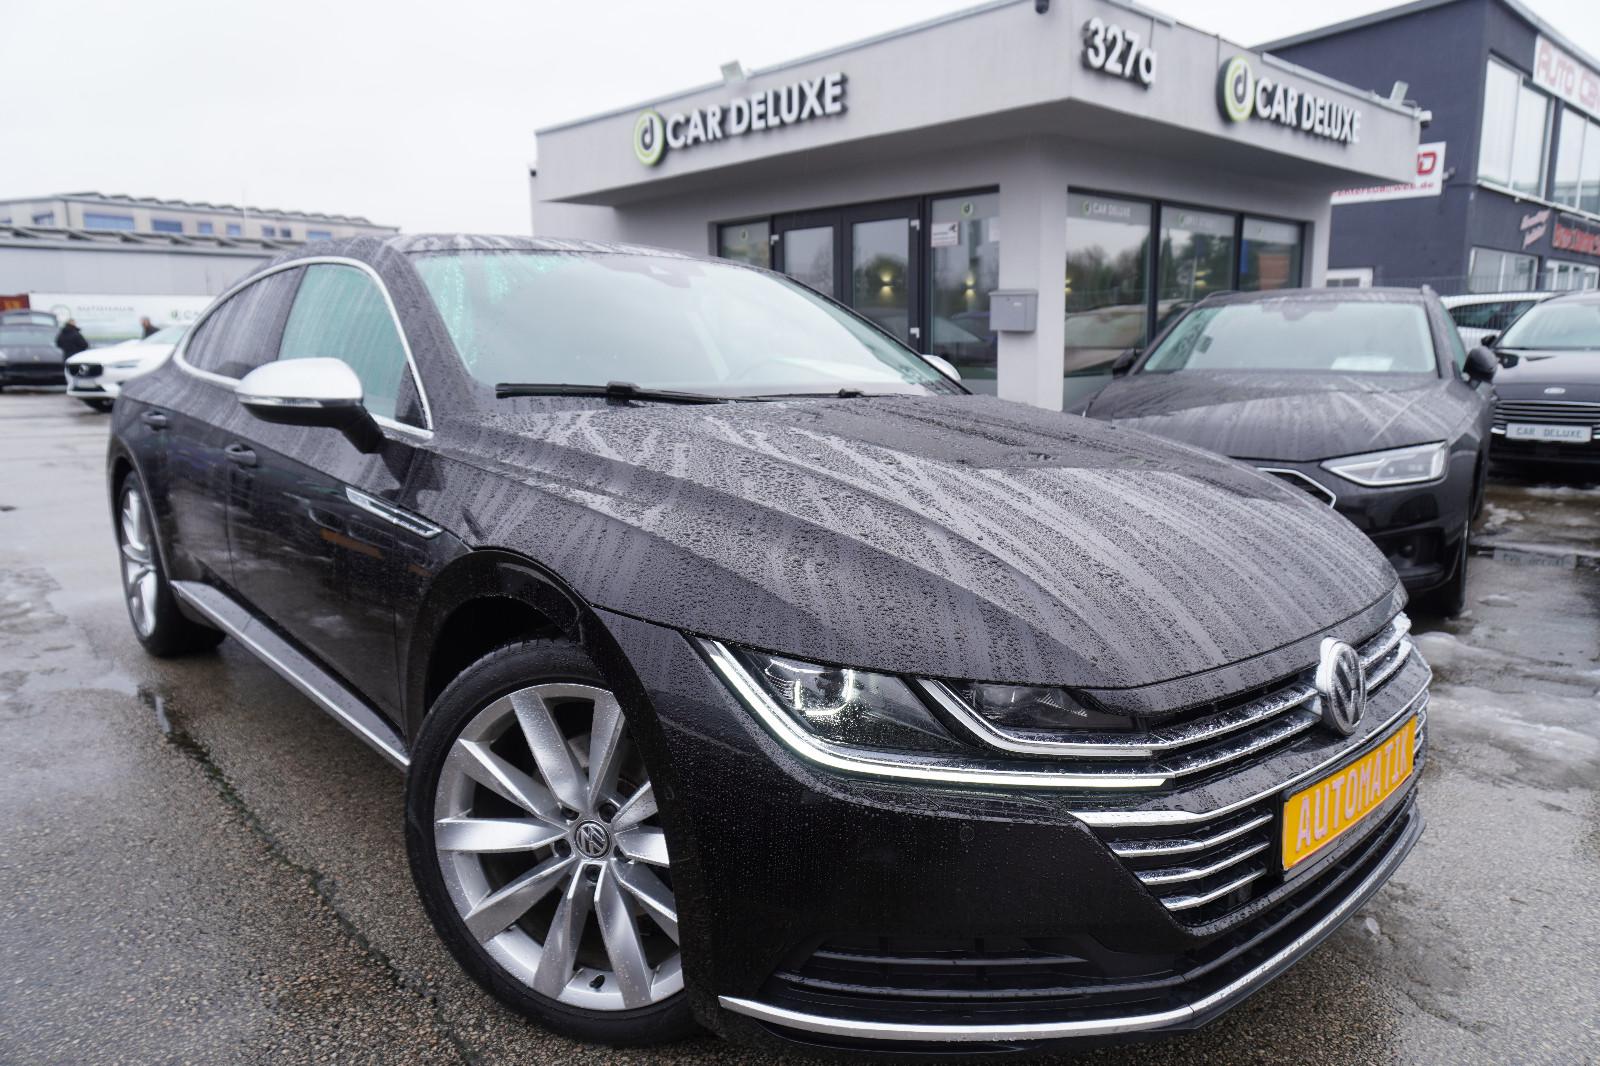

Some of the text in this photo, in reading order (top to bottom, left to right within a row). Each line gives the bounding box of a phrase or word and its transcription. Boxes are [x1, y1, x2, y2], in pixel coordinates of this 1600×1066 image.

[1086, 17, 1157, 84] 327a
[1537, 40, 1574, 96] AUTO
[666, 104, 723, 148] CAR
[730, 72, 843, 136] DELUXE
[1255, 78, 1298, 128] CAR
[1301, 94, 1361, 143] DELUXE
[1295, 726, 1409, 853] AUTOMATIK
